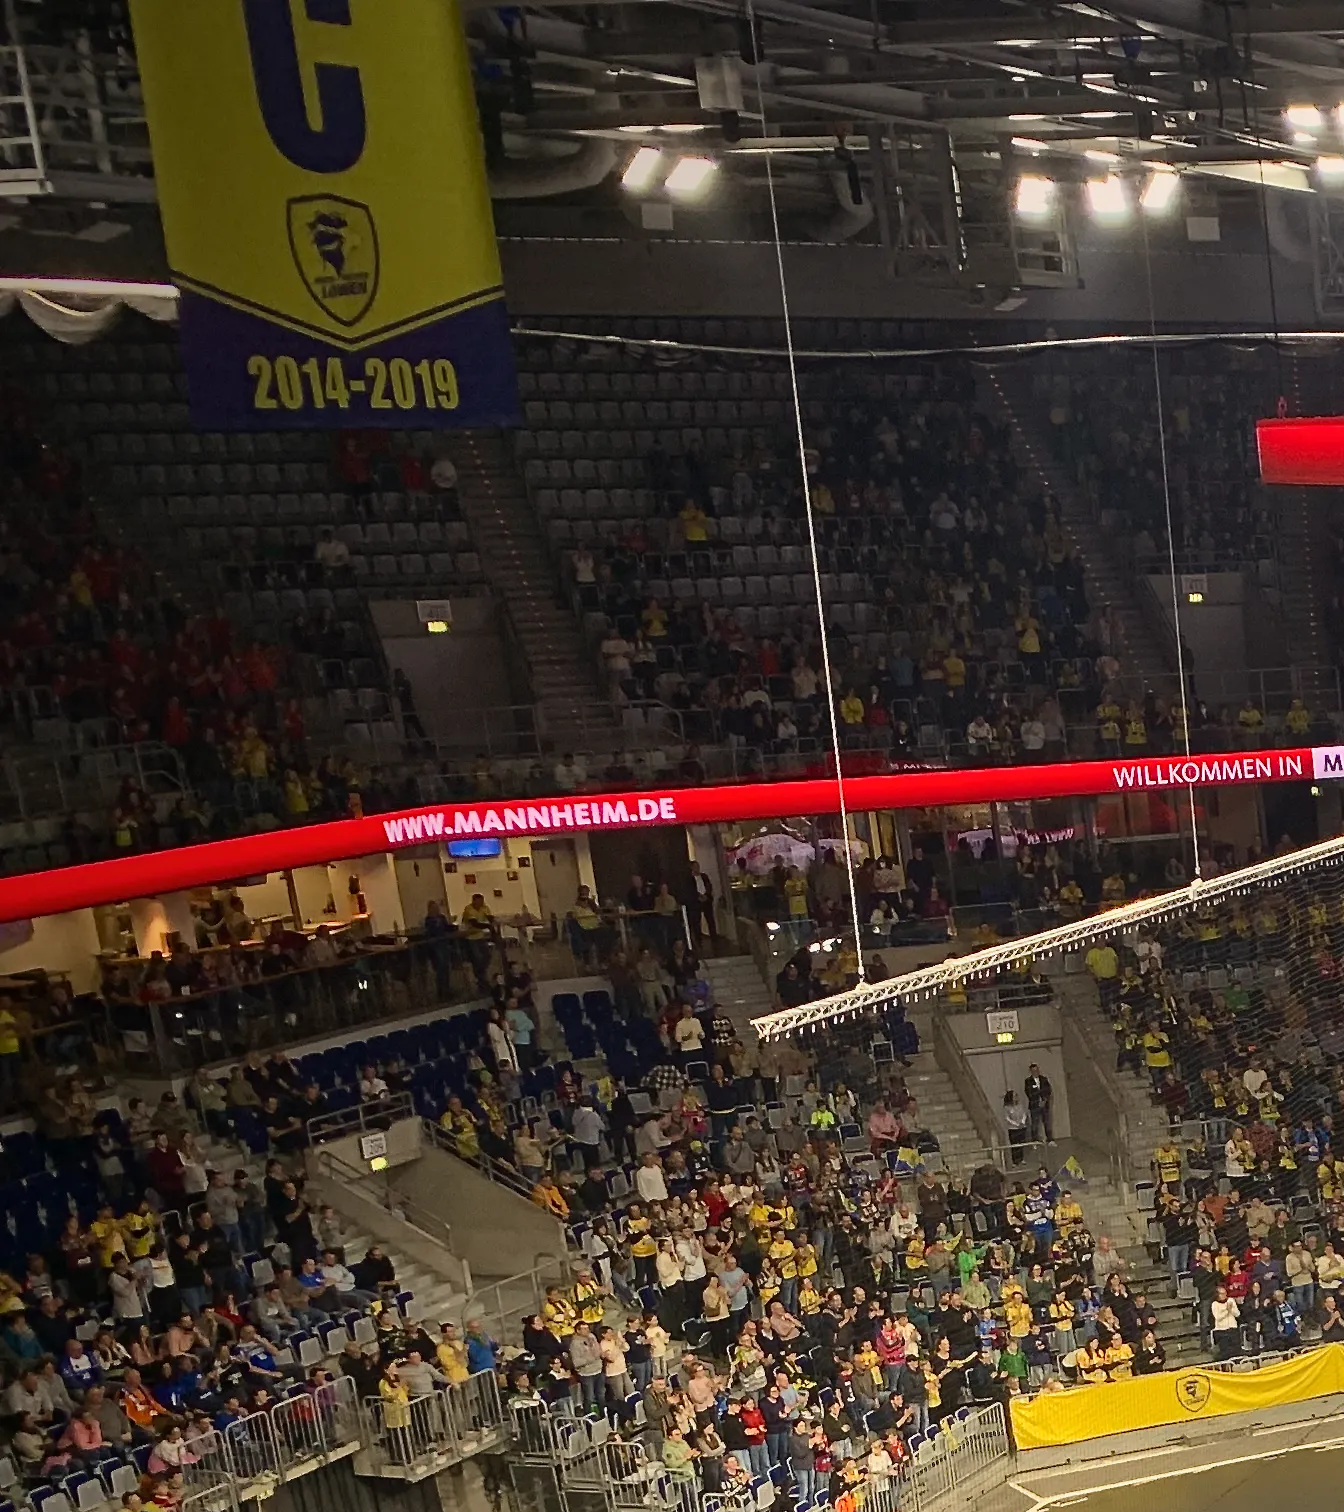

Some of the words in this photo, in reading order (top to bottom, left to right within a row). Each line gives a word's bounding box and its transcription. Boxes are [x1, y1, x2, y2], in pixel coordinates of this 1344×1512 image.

[247, 355, 459, 410] 2014-2019
[1113, 758, 1272, 788] WILLKOMMEN
[1279, 755, 1303, 776] IN
[383, 797, 676, 842] WWW.MANNHEIM.DE
